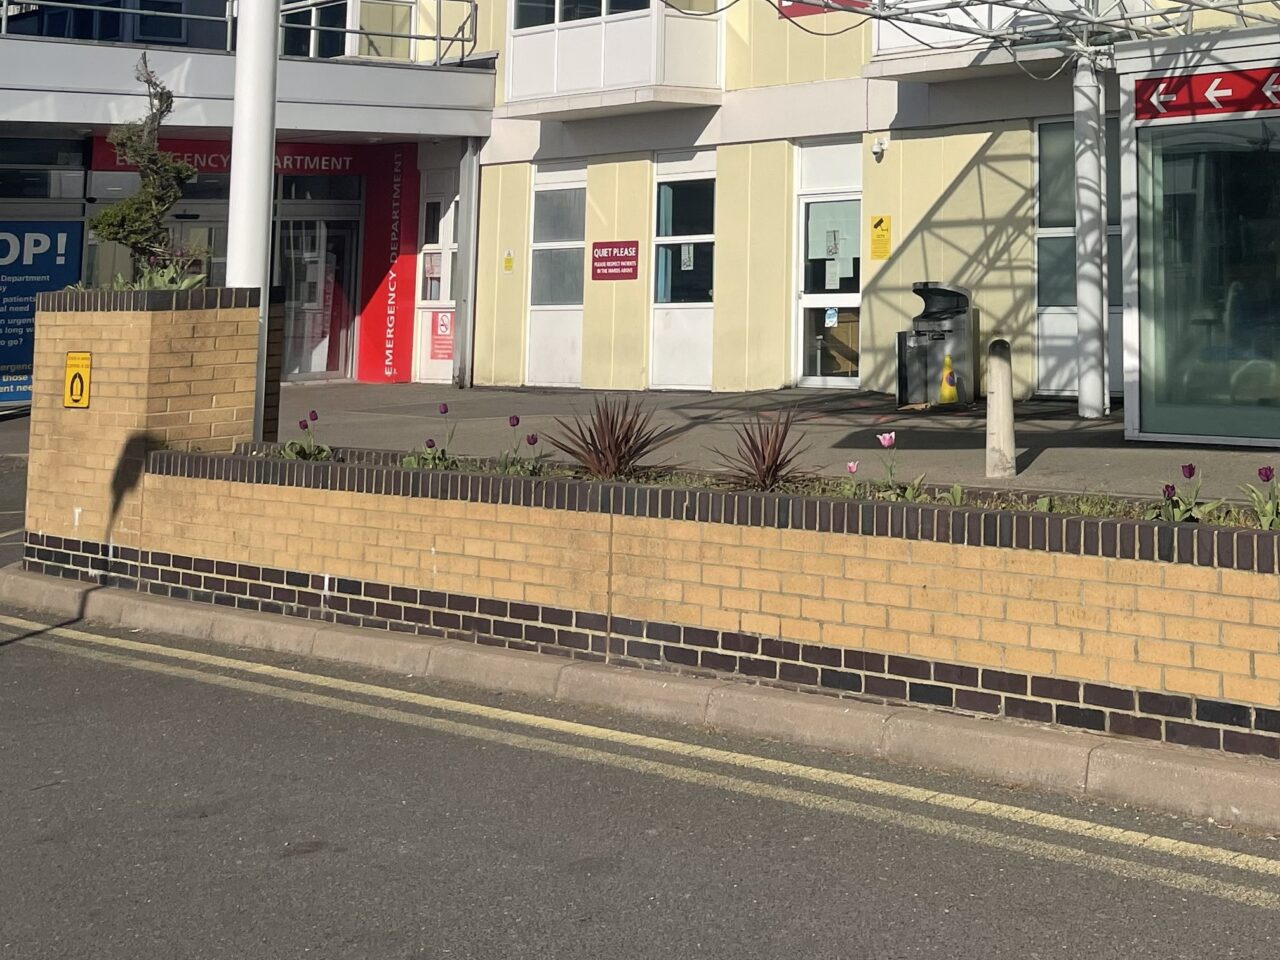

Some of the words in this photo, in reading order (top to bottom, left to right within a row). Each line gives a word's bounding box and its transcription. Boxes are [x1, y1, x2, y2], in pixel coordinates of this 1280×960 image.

[116, 150, 230, 168] EGENCY
[273, 155, 353, 170] ARTMENT
[389, 151, 403, 264] DEPARTMENT
[594, 248, 612, 258] QUIET
[613, 247, 636, 257] PLEASE
[1, 274, 50, 283] Department
[9, 304, 30, 312] need
[383, 269, 398, 377] EMERGENCY
[4, 326, 24, 335] long
[7, 338, 24, 347] go?
[1, 363, 33, 372] ergenc
